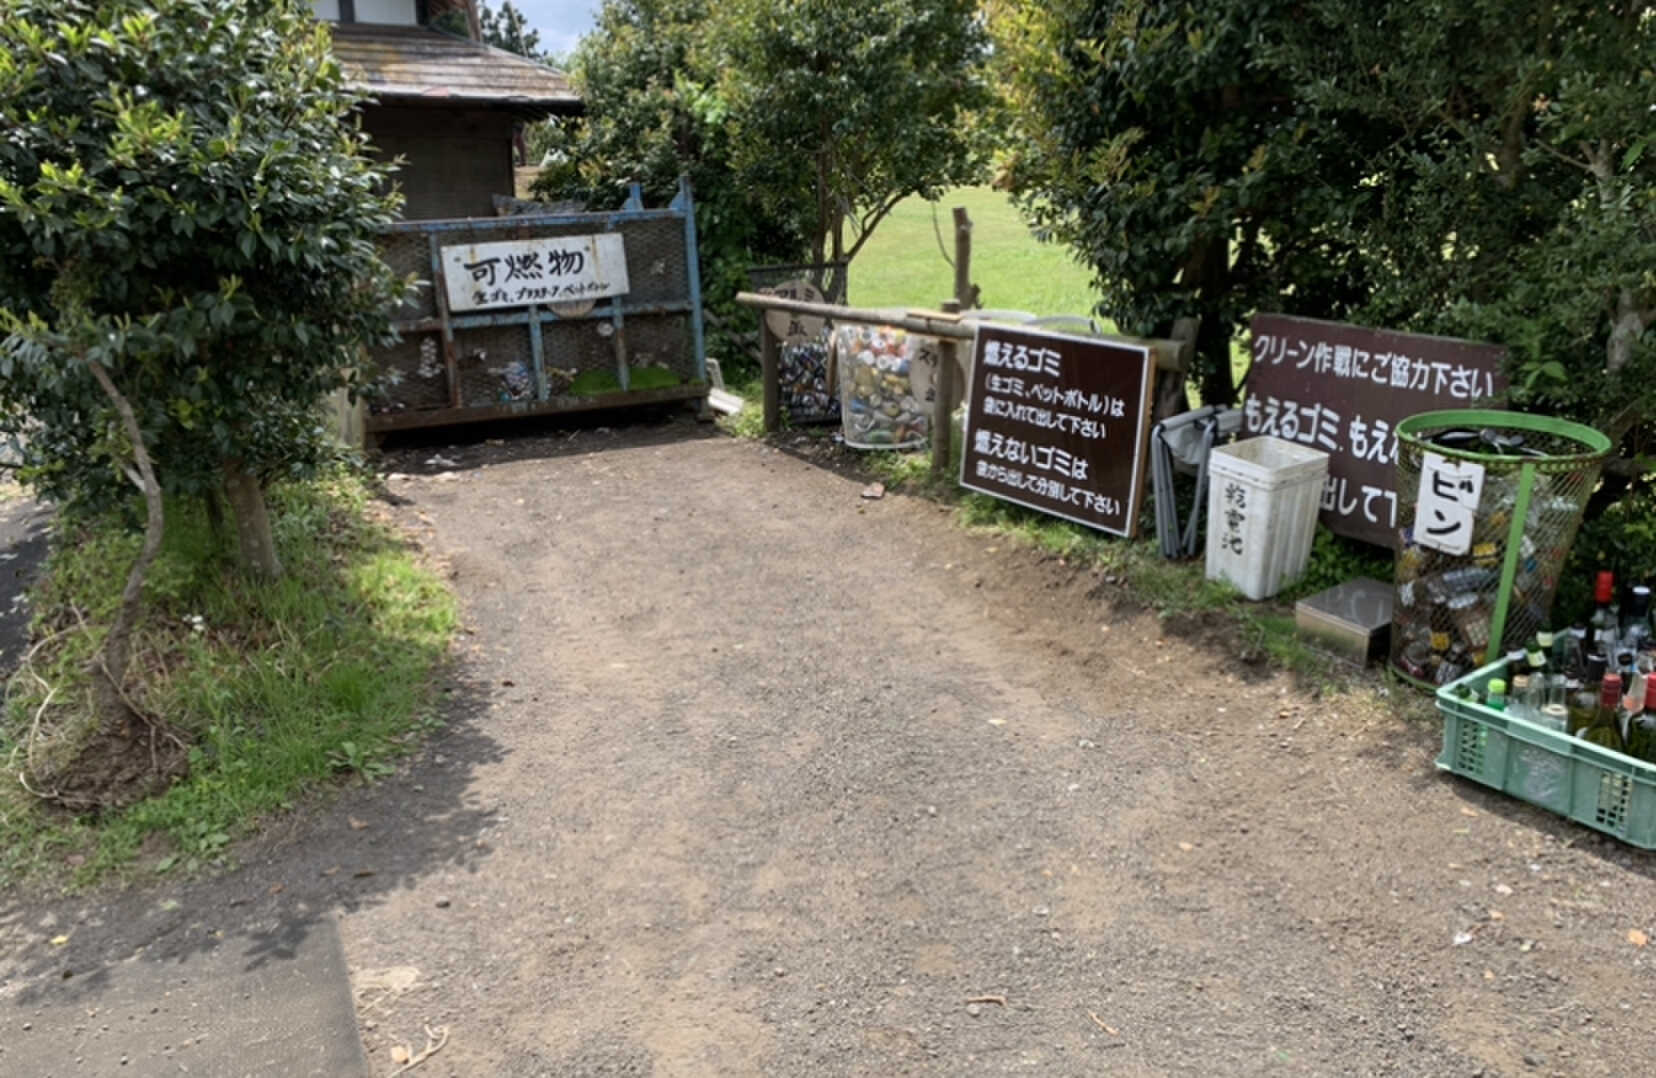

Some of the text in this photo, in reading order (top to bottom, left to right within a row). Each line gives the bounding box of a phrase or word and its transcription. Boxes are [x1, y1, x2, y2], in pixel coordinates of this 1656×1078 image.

[464, 248, 585, 287] 可燃物
[983, 339, 1062, 377] 燃えるゴミ
[1255, 334, 1494, 399] クリーン作戦にご協力下さい
[974, 428, 1089, 480] 燃えないゴミは
[1426, 469, 1475, 536] ビン
